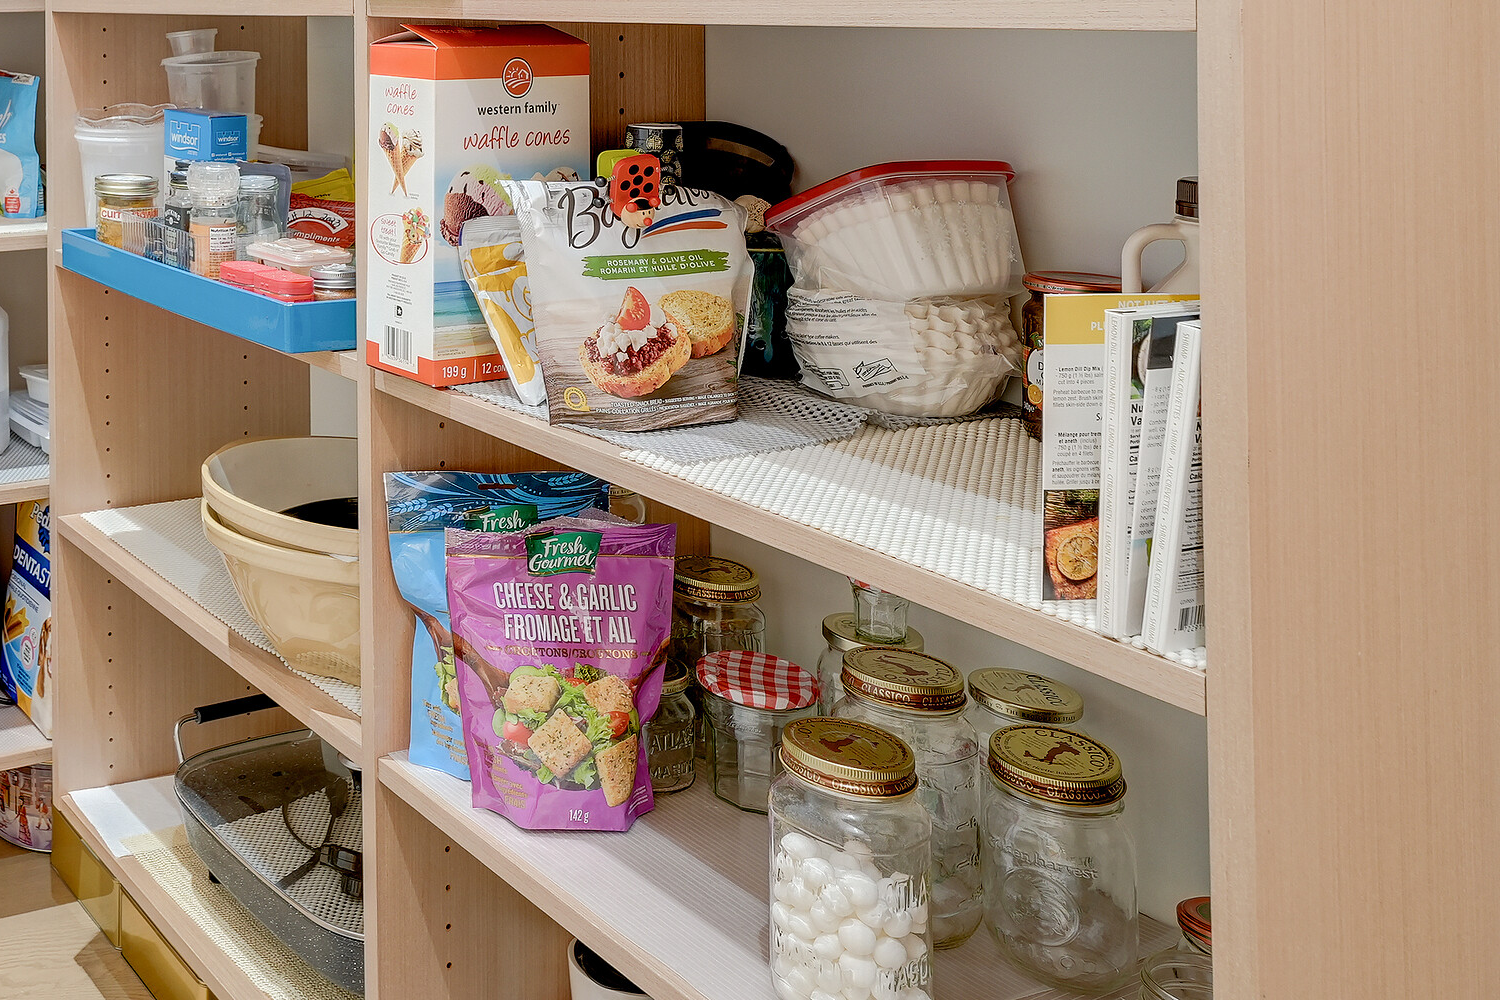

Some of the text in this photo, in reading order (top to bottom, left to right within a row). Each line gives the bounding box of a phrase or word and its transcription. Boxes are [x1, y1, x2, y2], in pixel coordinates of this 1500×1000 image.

[384, 83, 418, 117] waffle cones
[477, 100, 558, 116] western family
[171, 130, 198, 147] windsor
[217, 135, 239, 143] windsor
[463, 125, 571, 150] waffle cones
[600, 266, 637, 276] ROMARIN
[651, 263, 678, 273] HUILE
[680, 260, 716, 270] D'OLIVE
[606, 254, 704, 267] ROSEMARY & OLIVE OIL
[1118, 300, 1141, 309] NOT
[442, 364, 468, 380] 199 g
[481, 362, 492, 375] 12
[610, 401, 635, 409] TOASTED
[479, 509, 526, 531] Fresh
[541, 534, 587, 559] Fresh
[528, 549, 597, 572] Gourmet
[492, 581, 638, 612] CHEESE & GARLIC
[686, 586, 727, 600] CLASSICO
[503, 612, 638, 644] FROMAGE ET AIL
[861, 683, 911, 703] CLASSICO
[1005, 708, 1052, 721] THE REGIONS
[650, 728, 694, 755] ATLAS
[1034, 729, 1106, 769] CLASSICO
[830, 779, 886, 796] CLASSICO
[1046, 786, 1101, 801] CLASSICO
[568, 808, 583, 822] 142
[1033, 851, 1099, 880] harvest
